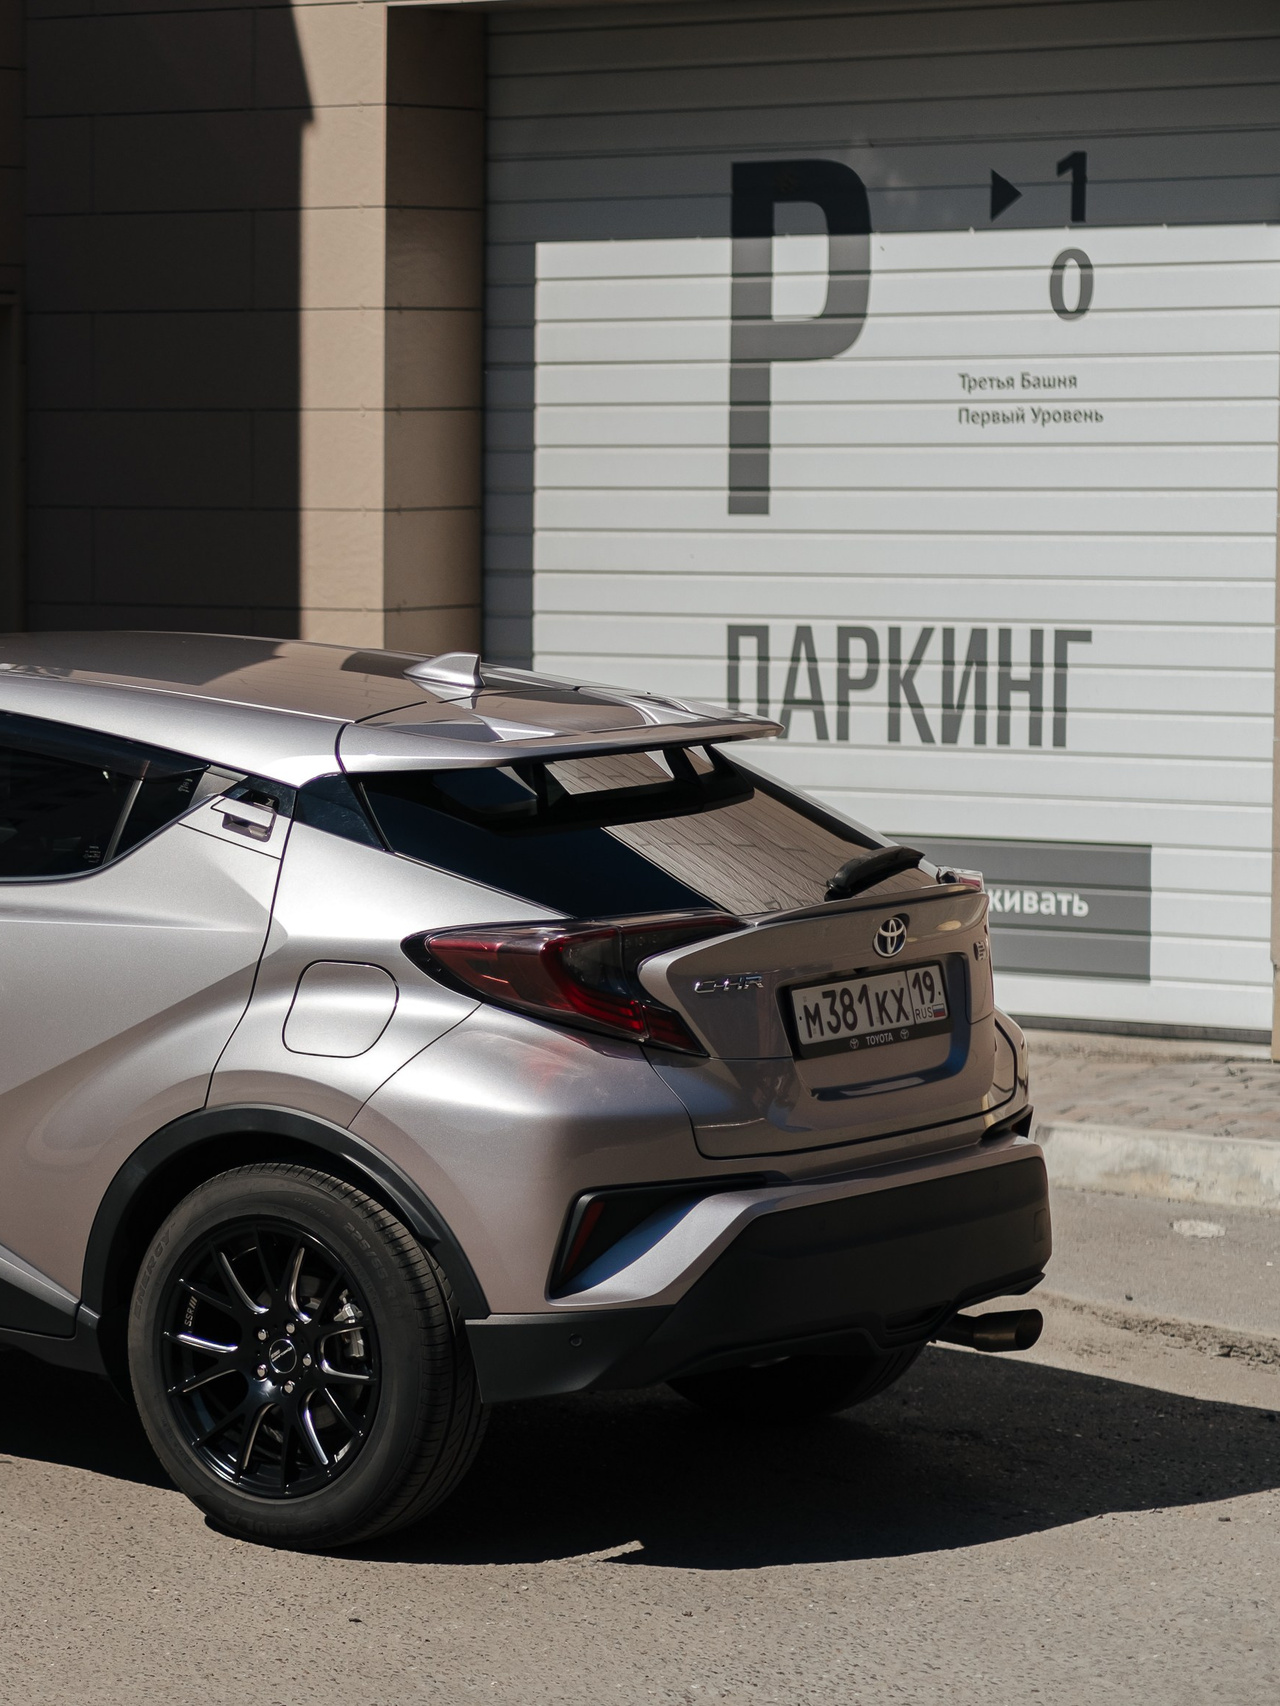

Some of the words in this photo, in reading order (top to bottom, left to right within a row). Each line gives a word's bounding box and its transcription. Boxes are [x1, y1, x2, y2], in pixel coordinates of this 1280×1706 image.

[1056, 150, 1087, 222] 1
[1049, 247, 1094, 321] 0
[958, 373, 1015, 394] Третья
[1021, 372, 1077, 390] Башня
[958, 406, 1025, 428] Первый
[1031, 406, 1104, 427] Уровень
[727, 624, 1093, 749] ПАРКИНГ
[915, 1007, 933, 1021] RUS
[865, 1032, 894, 1046] TOYOTA
